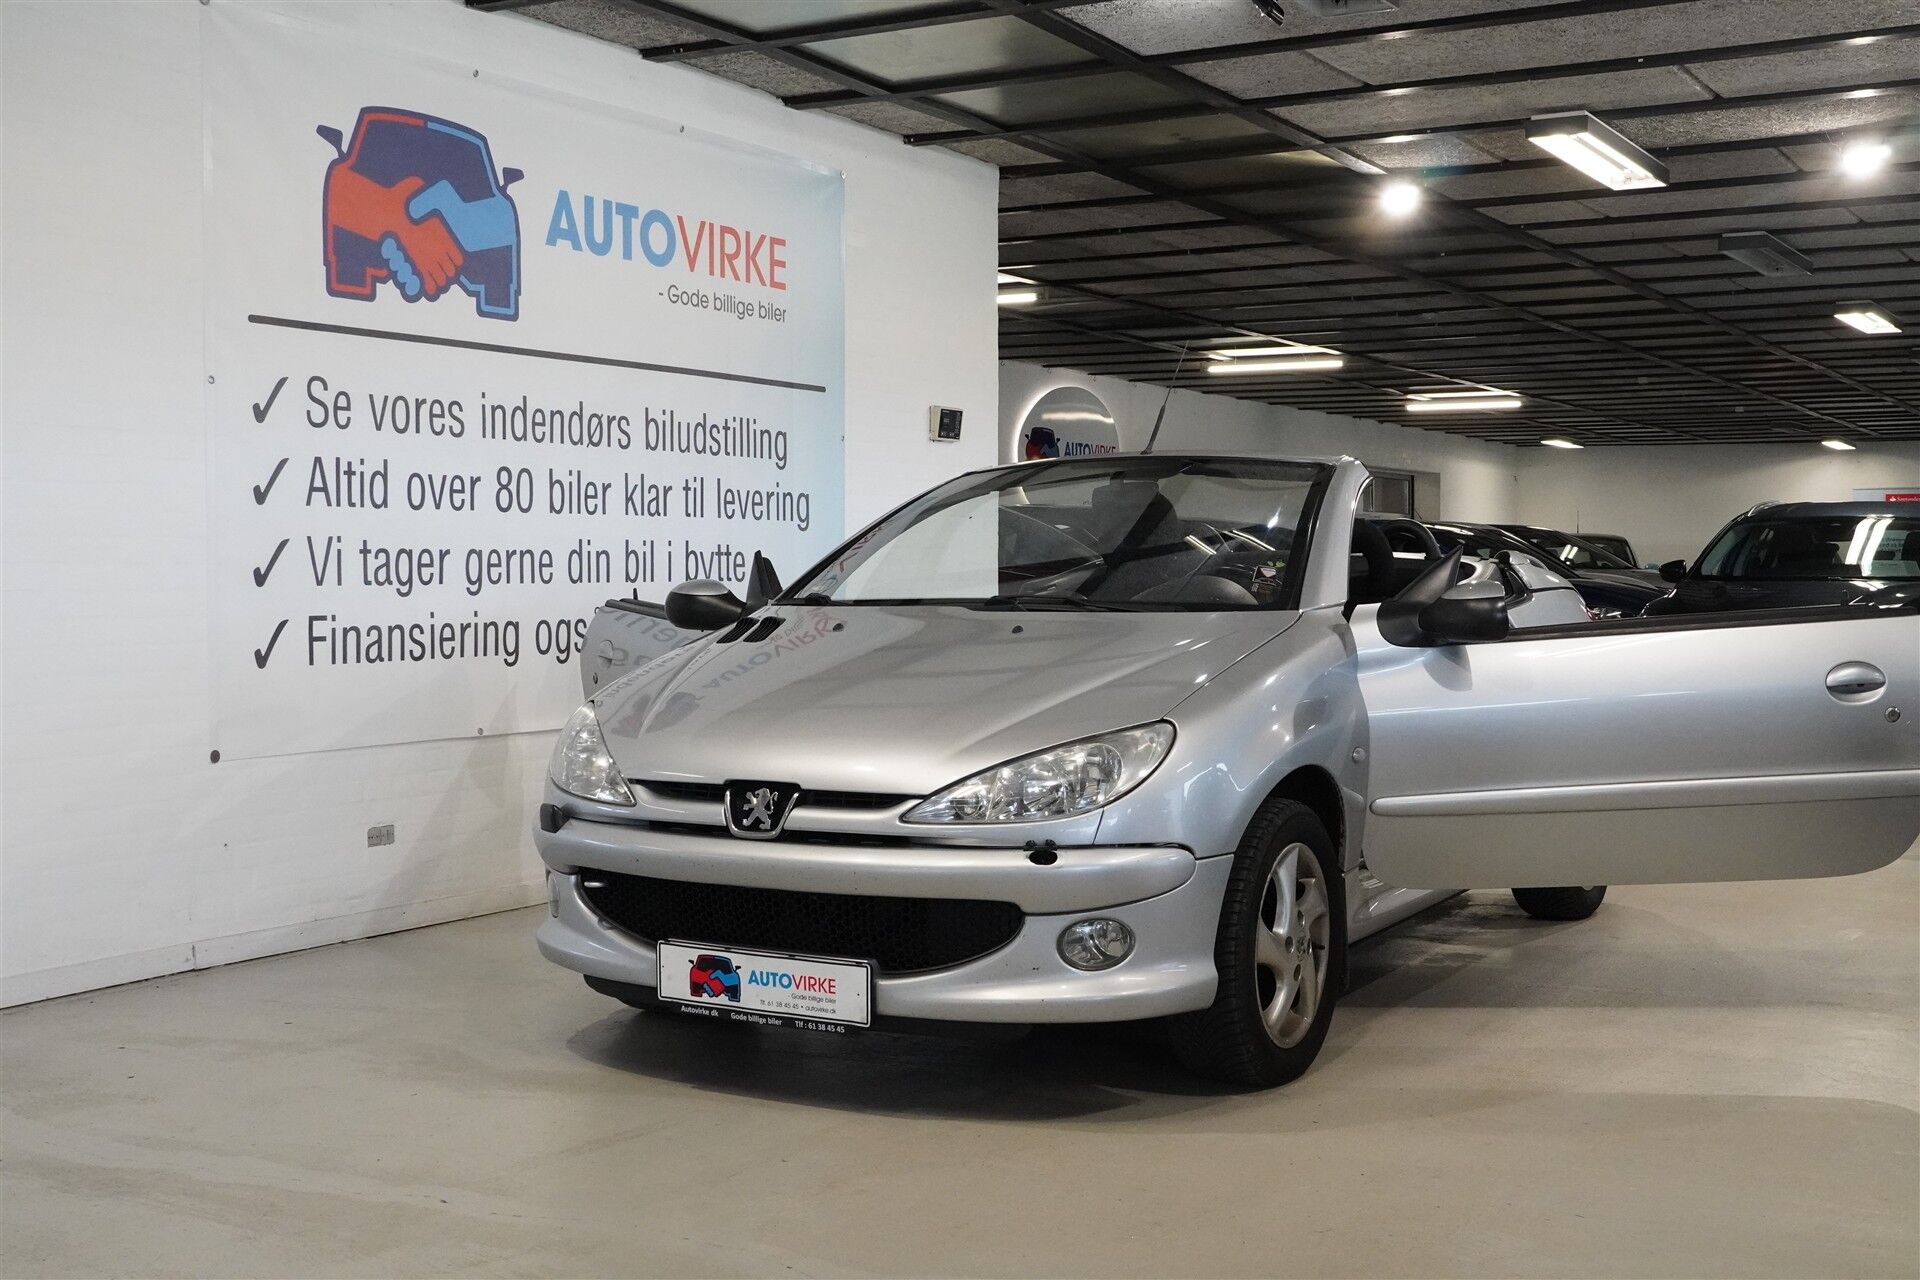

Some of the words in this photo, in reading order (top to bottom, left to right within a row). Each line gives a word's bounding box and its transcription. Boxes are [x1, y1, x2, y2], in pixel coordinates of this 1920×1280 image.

[546, 190, 787, 290] AUTOVIRKE
[667, 284, 710, 309] Gode
[713, 292, 755, 320] billige
[758, 300, 787, 323] biler
[306, 375, 352, 431] Se
[368, 393, 465, 438] vores
[481, 392, 632, 450] indendørs
[645, 408, 788, 470] biludstilling
[306, 456, 388, 510] Altid
[407, 472, 482, 511] over
[495, 465, 534, 515] 80
[548, 469, 612, 517] biler
[625, 472, 673, 518] klar
[683, 476, 705, 519] til
[716, 477, 811, 532] levering
[306, 535, 343, 587] Vi
[358, 540, 451, 598] tager
[465, 548, 554, 597] gerne
[567, 538, 611, 585] din
[625, 539, 656, 584] bil
[667, 539, 673, 583] i
[308, 615, 520, 667] Finansiering
[535, 610, 599, 665] ogs
[748, 969, 836, 994] AUTOVIRKE
[731, 1012, 747, 1021] Gode
[748, 1015, 767, 1024] billige
[768, 1017, 783, 1026] biler
[808, 1022, 816, 1030] 61
[817, 1023, 826, 1031] 38
[827, 1024, 835, 1032] 45
[836, 1025, 845, 1033] 45
